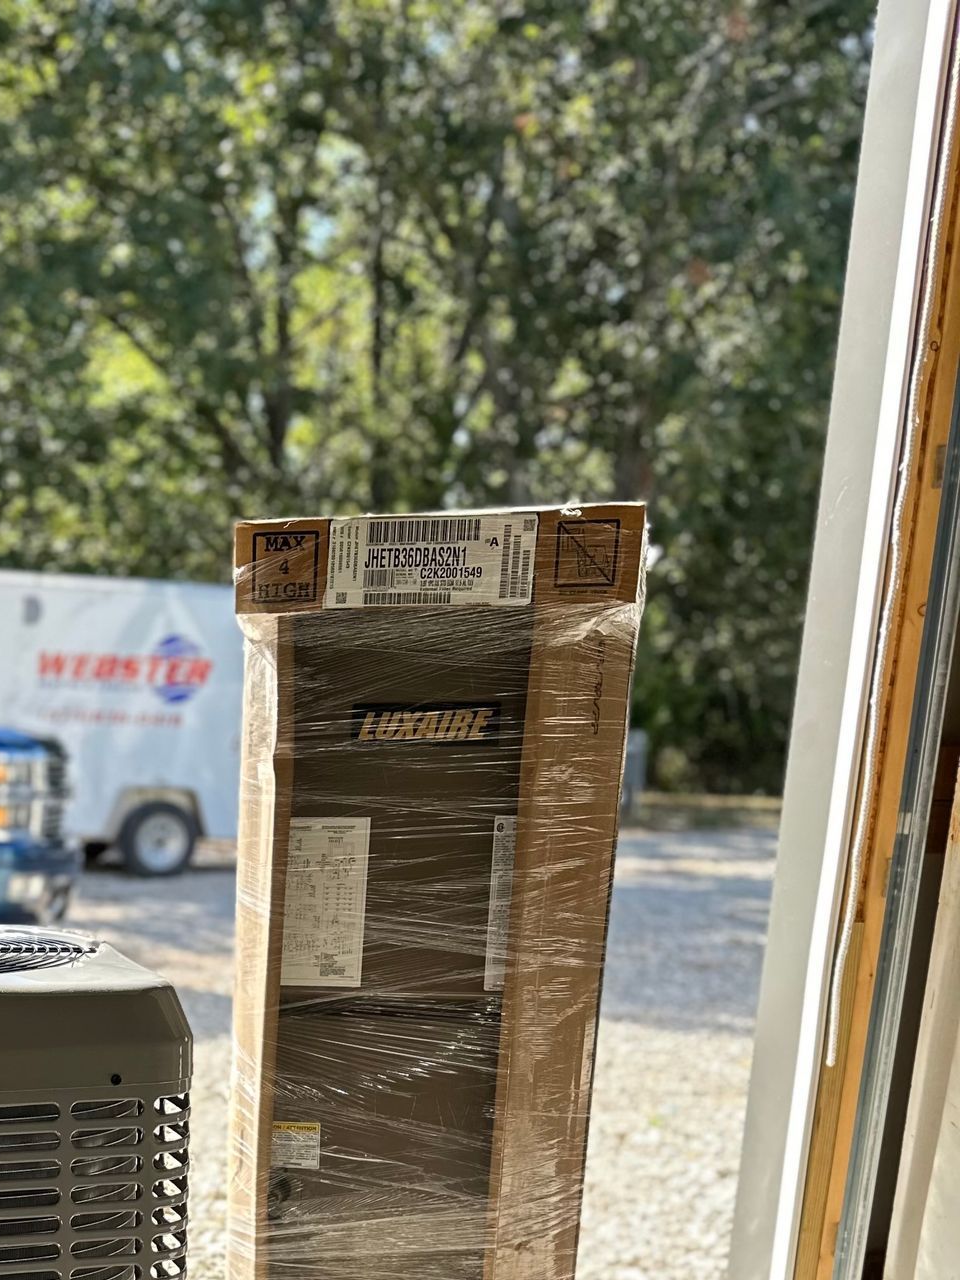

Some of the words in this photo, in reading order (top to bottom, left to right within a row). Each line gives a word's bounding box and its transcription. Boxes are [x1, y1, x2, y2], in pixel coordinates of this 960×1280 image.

[264, 535, 306, 552] MAX
[489, 536, 499, 547] A
[364, 546, 468, 569] JHETB36DBAS2N1
[279, 559, 290, 575] 4
[420, 565, 483, 580] C2K2001549
[258, 581, 311, 599] HIGH
[38, 650, 213, 687] WEBSTER
[358, 709, 494, 741] LUXAIRE
